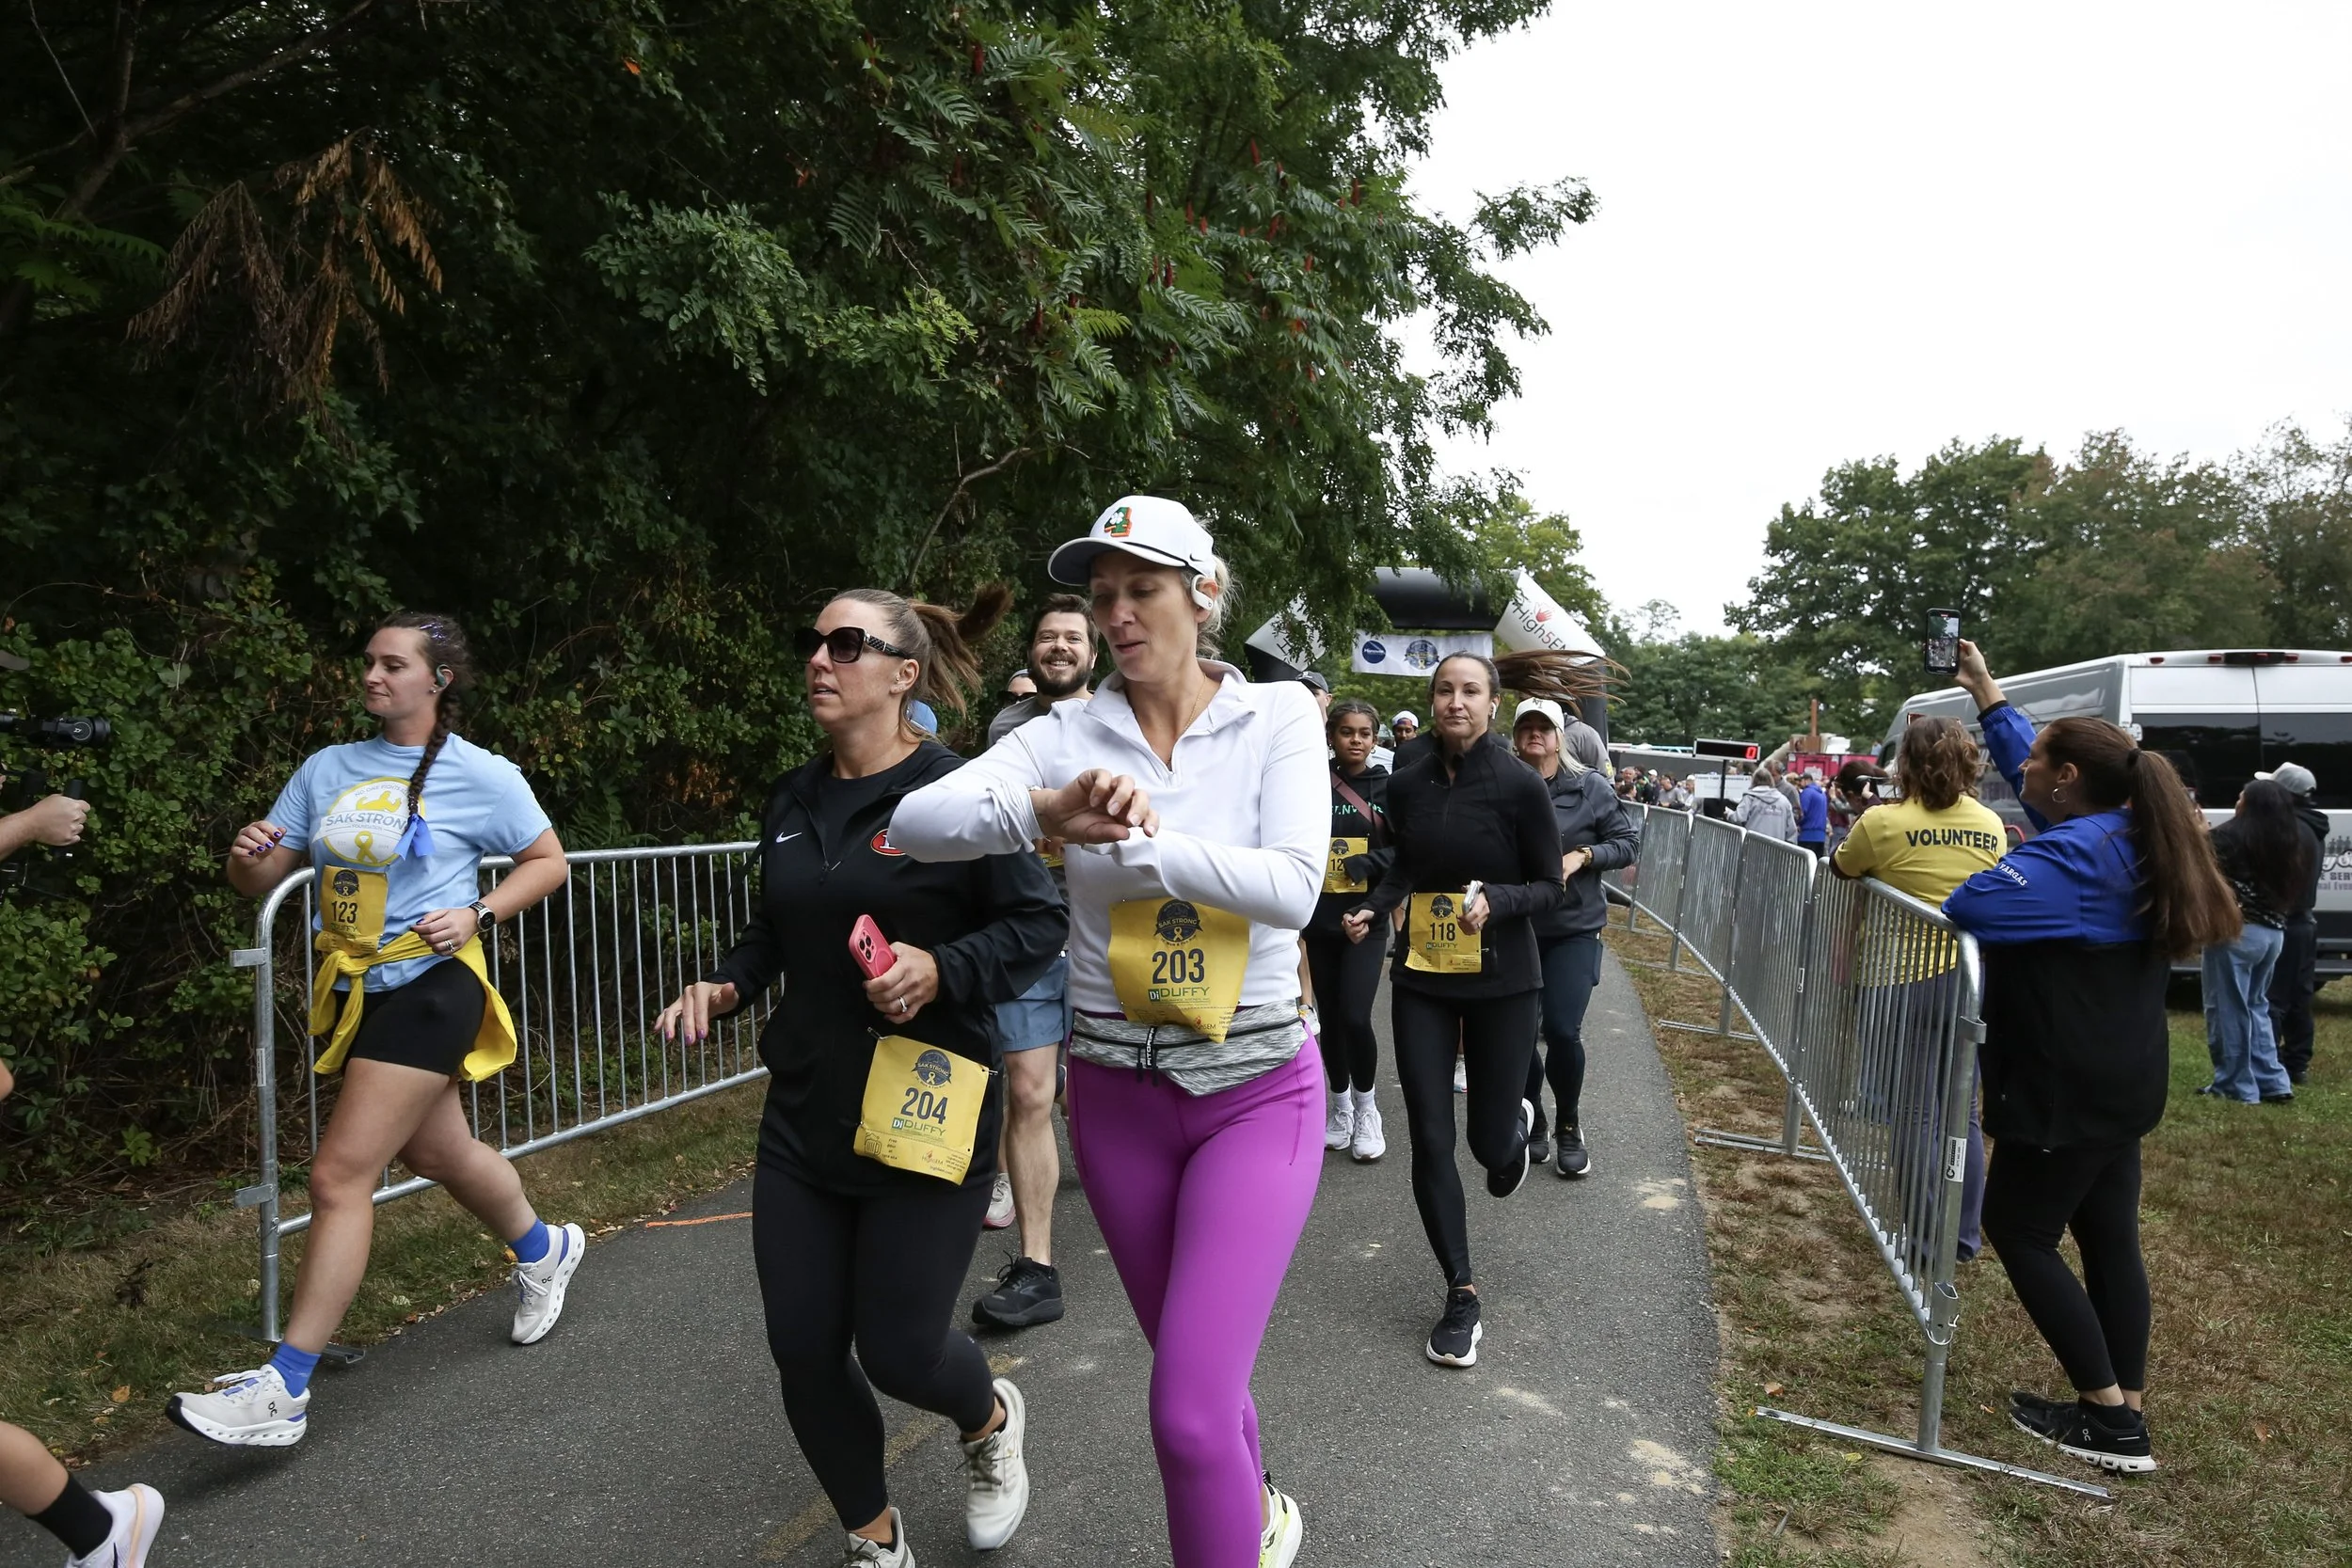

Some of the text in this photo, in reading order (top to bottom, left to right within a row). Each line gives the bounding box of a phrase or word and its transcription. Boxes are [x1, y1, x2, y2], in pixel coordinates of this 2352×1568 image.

[1745, 747, 1756, 759] 0
[326, 813, 407, 830] SAK STRON
[1906, 829, 1998, 851] VOLUNTEER
[1330, 859, 1343, 871] 12
[1999, 863, 2027, 886] VARGAS
[2330, 872, 2352, 881] SER
[331, 901, 358, 924] 123
[1158, 920, 1171, 928] SAK
[1429, 923, 1455, 942] 118
[1152, 948, 1205, 984] 203
[1160, 987, 1210, 997] DUFFY
[929, 1064, 949, 1076] STRONG
[900, 1087, 948, 1124] 204
[904, 1118, 946, 1136] DUFFY
